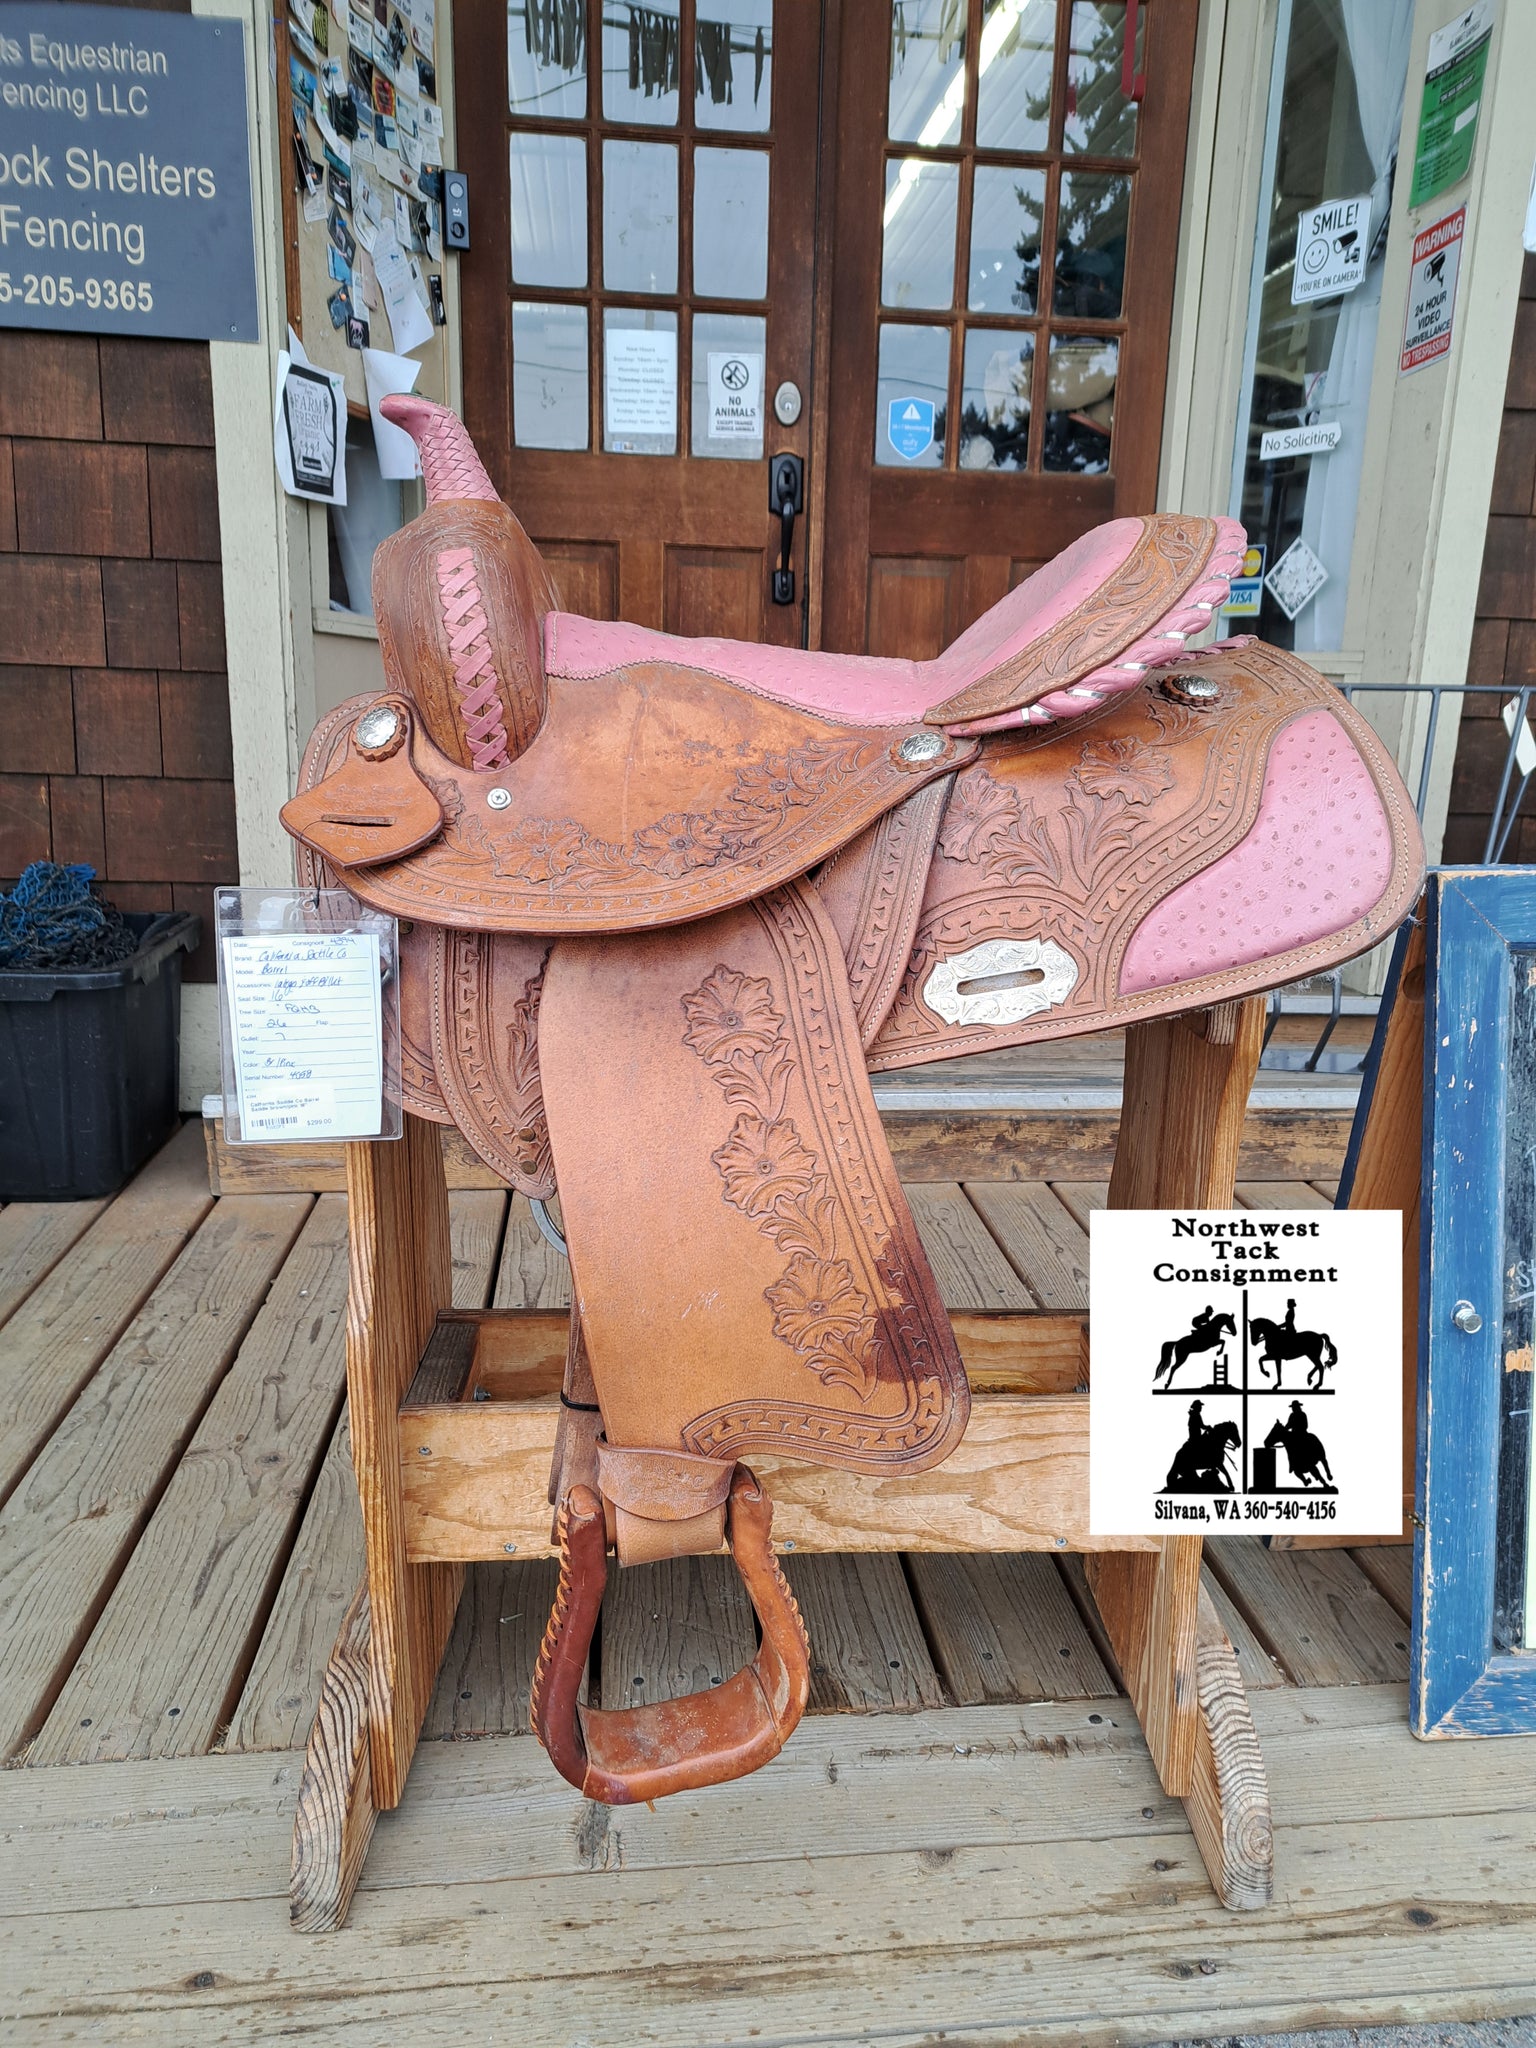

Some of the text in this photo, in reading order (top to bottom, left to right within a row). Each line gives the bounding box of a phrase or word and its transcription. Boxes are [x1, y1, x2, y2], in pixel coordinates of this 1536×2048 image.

[29, 33, 168, 76] Equestrian
[0, 78, 149, 118] encing LLC
[65, 147, 217, 199] Shelters
[0, 204, 145, 265] Fencing
[1312, 203, 1359, 236] SMILE!
[1415, 214, 1463, 259] WARNING
[0, 272, 153, 312] 5-205-9365
[1322, 276, 1332, 288] ON
[1414, 290, 1447, 318] 24 HOUR
[1418, 308, 1441, 331] VIDEO
[1405, 318, 1452, 350] SURVEILLANCE
[1402, 334, 1450, 367] NO TRESPASSING
[715, 407, 756, 417] ANIMALS
[729, 396, 741, 405] NO
[1265, 430, 1335, 452] No Soliciting
[1230, 591, 1252, 603] VISA
